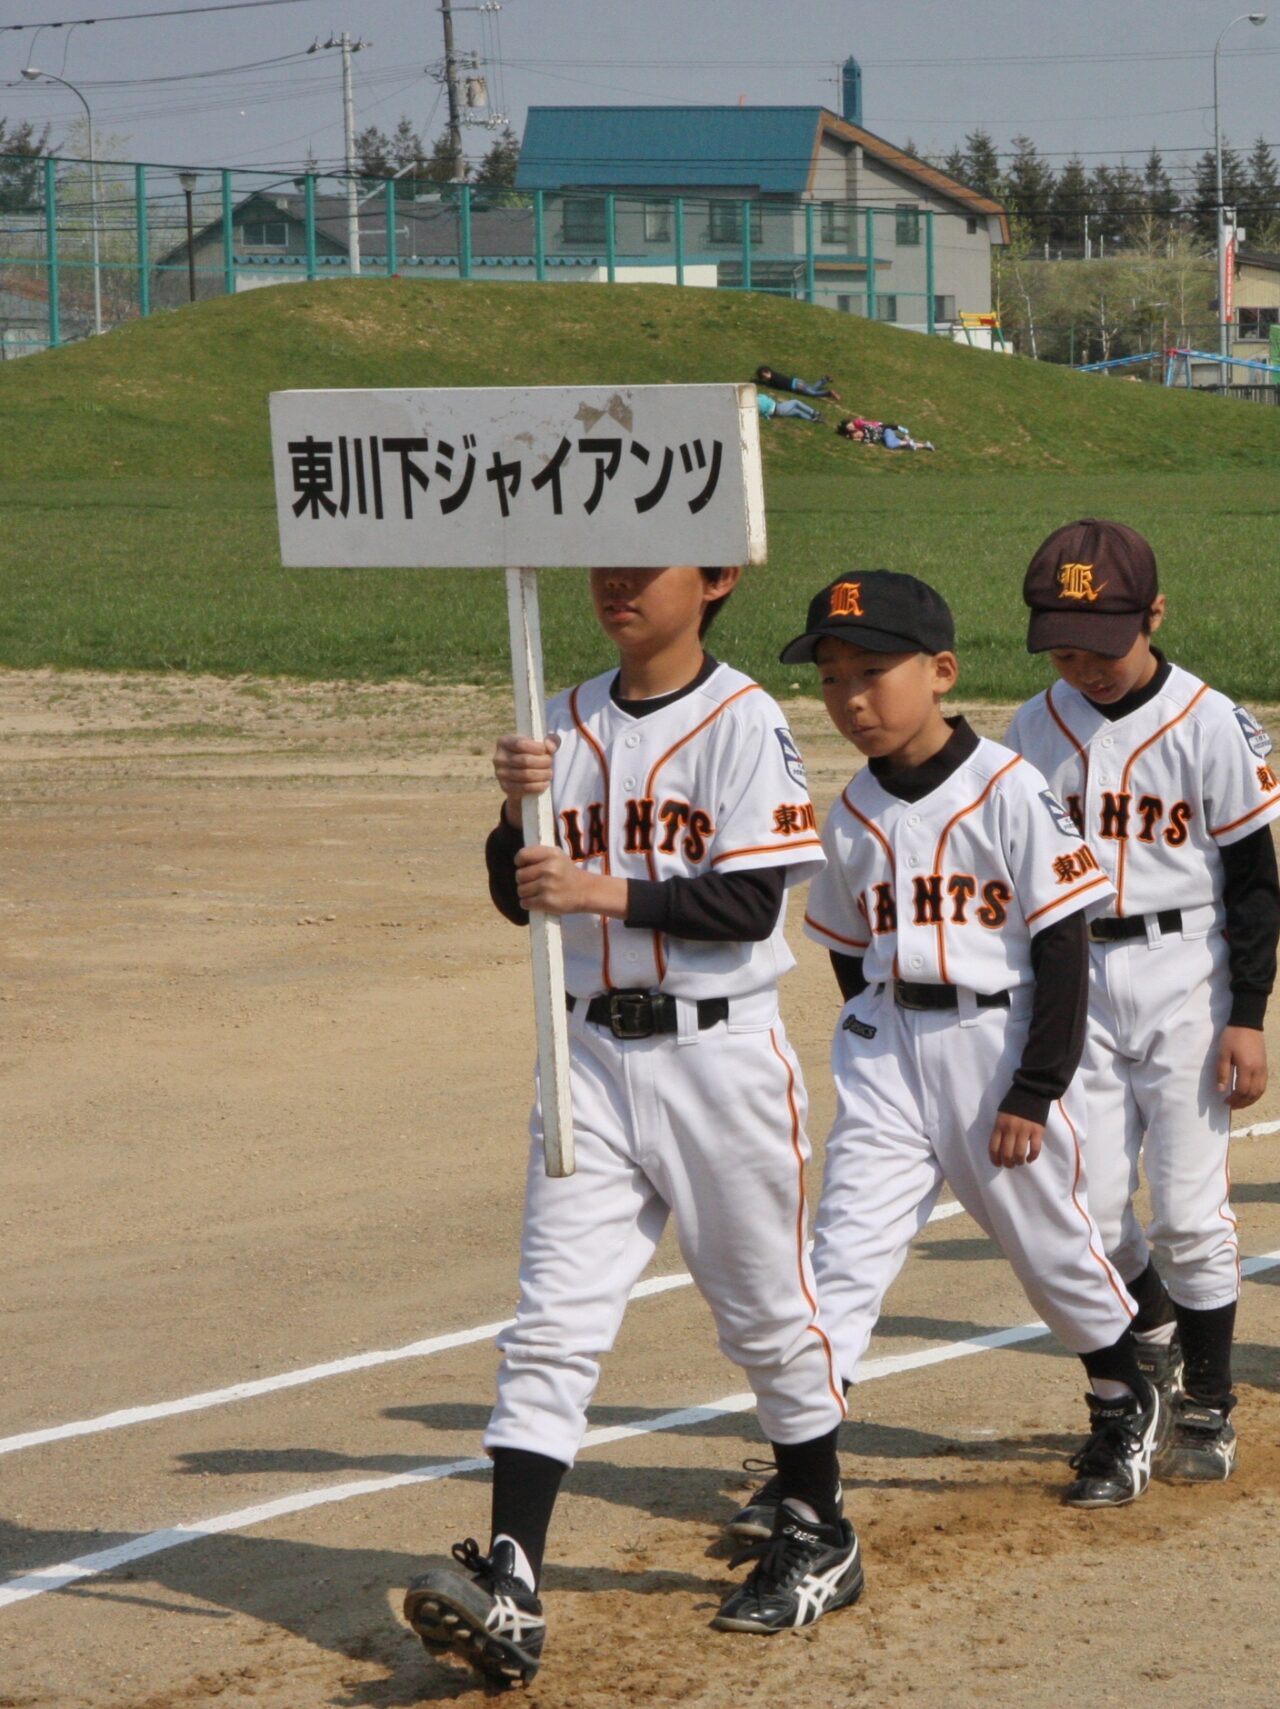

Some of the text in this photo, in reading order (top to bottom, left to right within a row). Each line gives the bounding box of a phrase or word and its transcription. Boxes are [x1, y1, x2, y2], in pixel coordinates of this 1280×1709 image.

[287, 435, 724, 520] 東川下ジャイアンツ
[559, 797, 716, 865] IANTS
